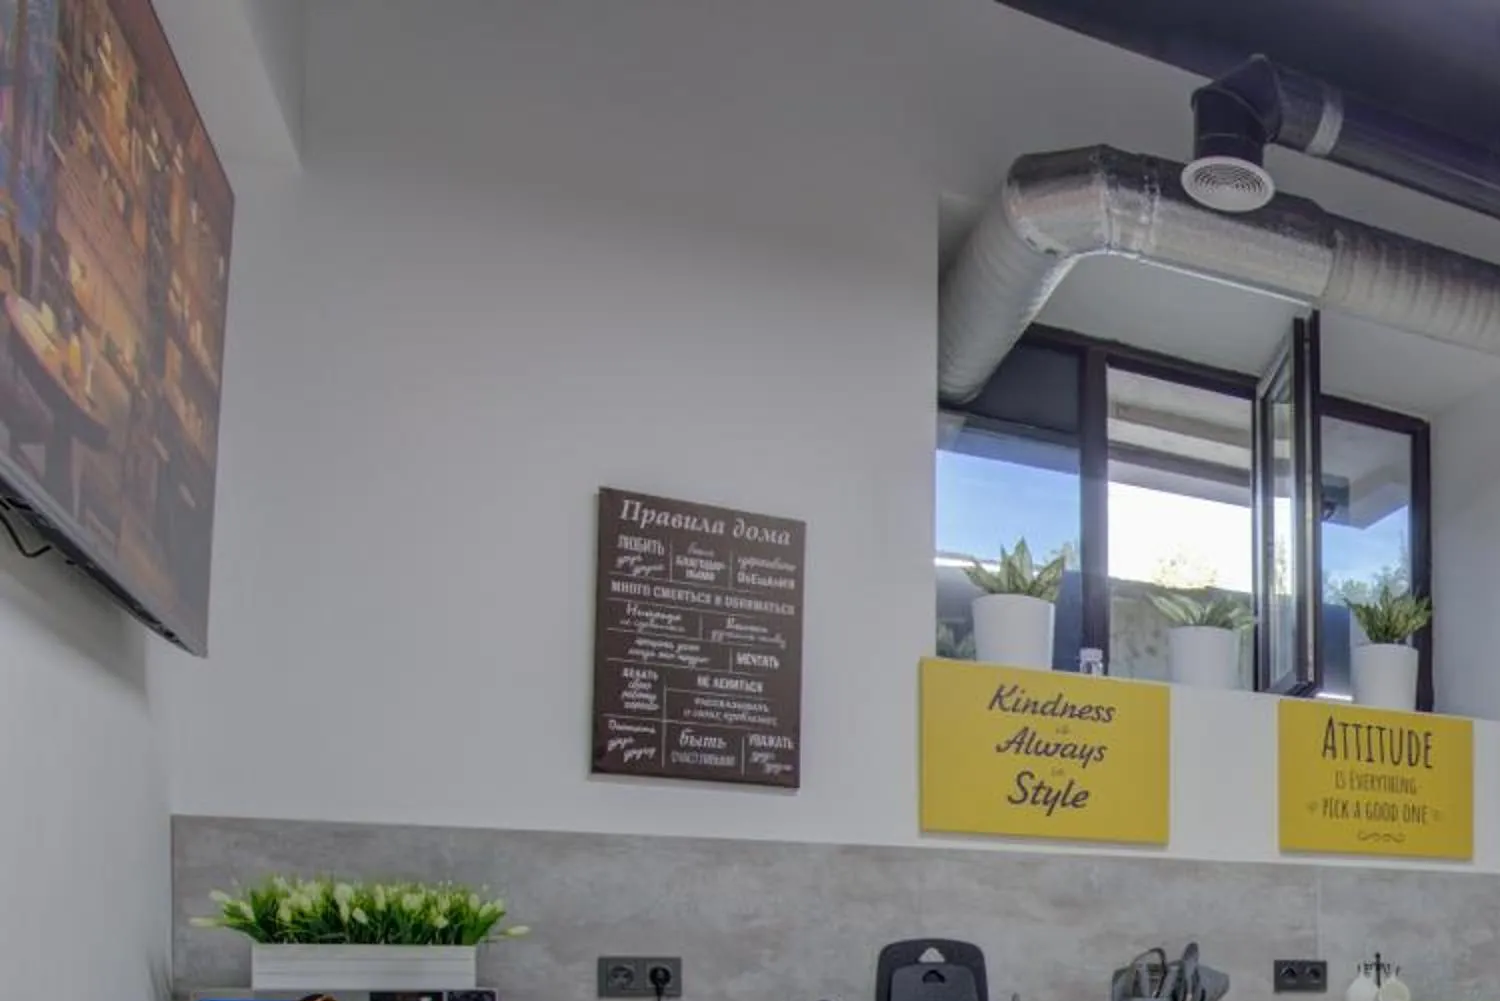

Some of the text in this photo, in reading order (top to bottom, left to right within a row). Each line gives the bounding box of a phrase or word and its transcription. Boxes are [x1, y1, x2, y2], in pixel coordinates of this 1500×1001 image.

[620, 499, 792, 545] Правила дома
[610, 580, 651, 596] МНОГО
[987, 683, 1117, 723] Kindness
[996, 726, 1109, 768] Always
[1321, 715, 1434, 769] ATTITUDE
[1007, 770, 1090, 817] Style
[1353, 800, 1361, 819] A
[1364, 801, 1399, 822] GOOD
[1402, 803, 1428, 824] ONE
